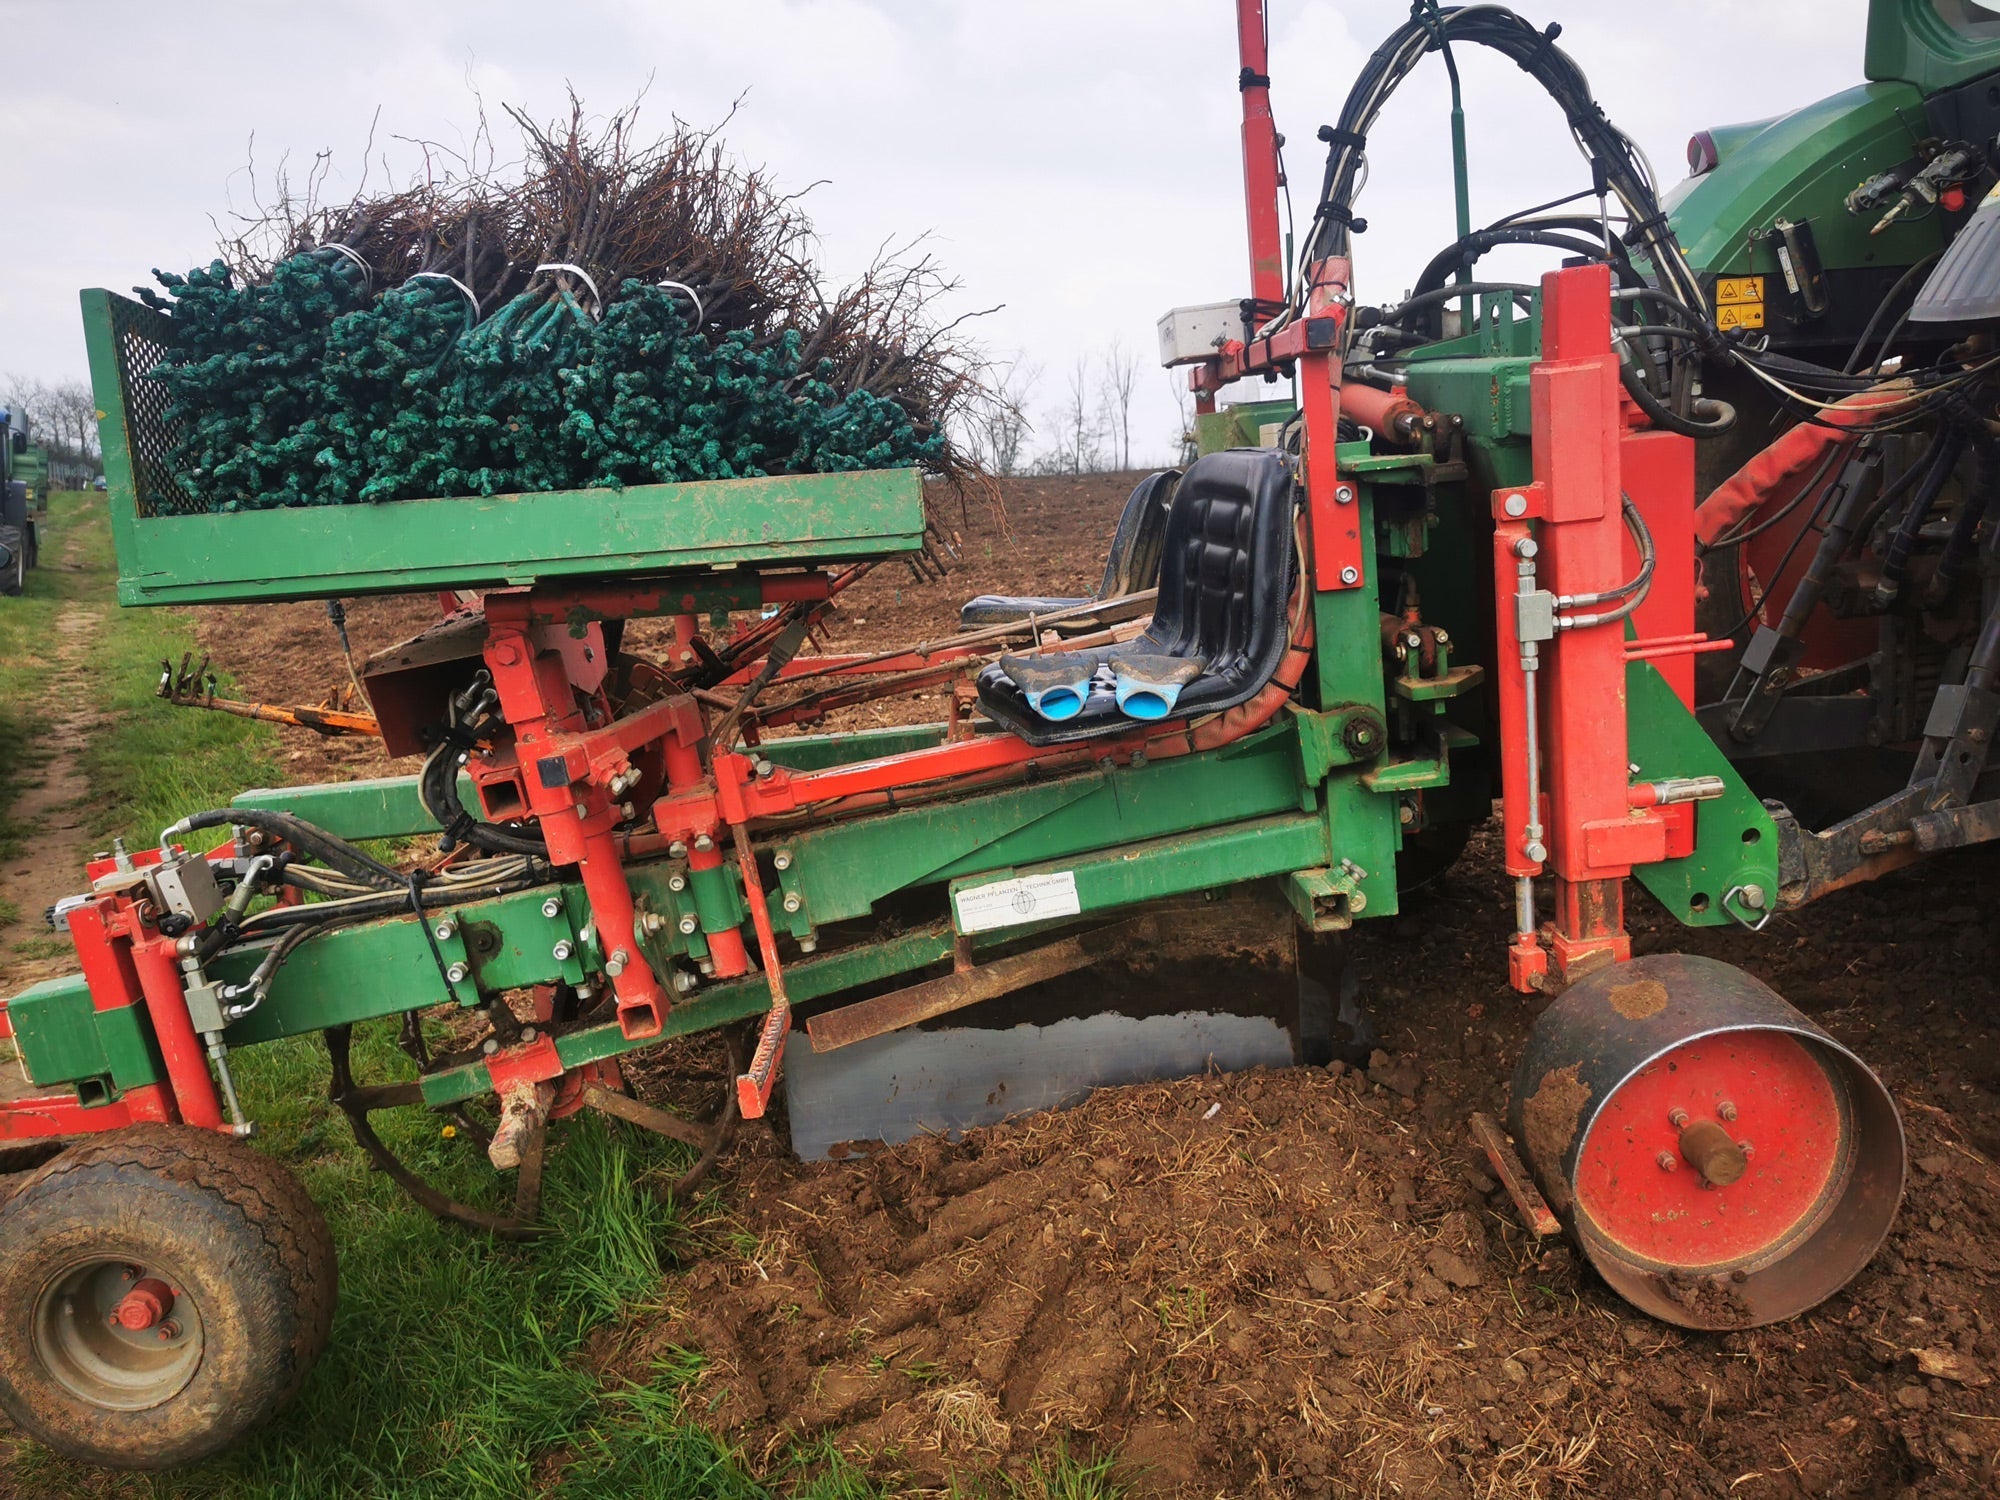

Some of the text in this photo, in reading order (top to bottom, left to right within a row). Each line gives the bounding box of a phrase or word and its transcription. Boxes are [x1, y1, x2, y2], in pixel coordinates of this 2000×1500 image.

[960, 892, 985, 903] WAGNER
[988, 887, 1018, 897] PFLANZEN
[1026, 881, 1051, 889] TECHNIK
